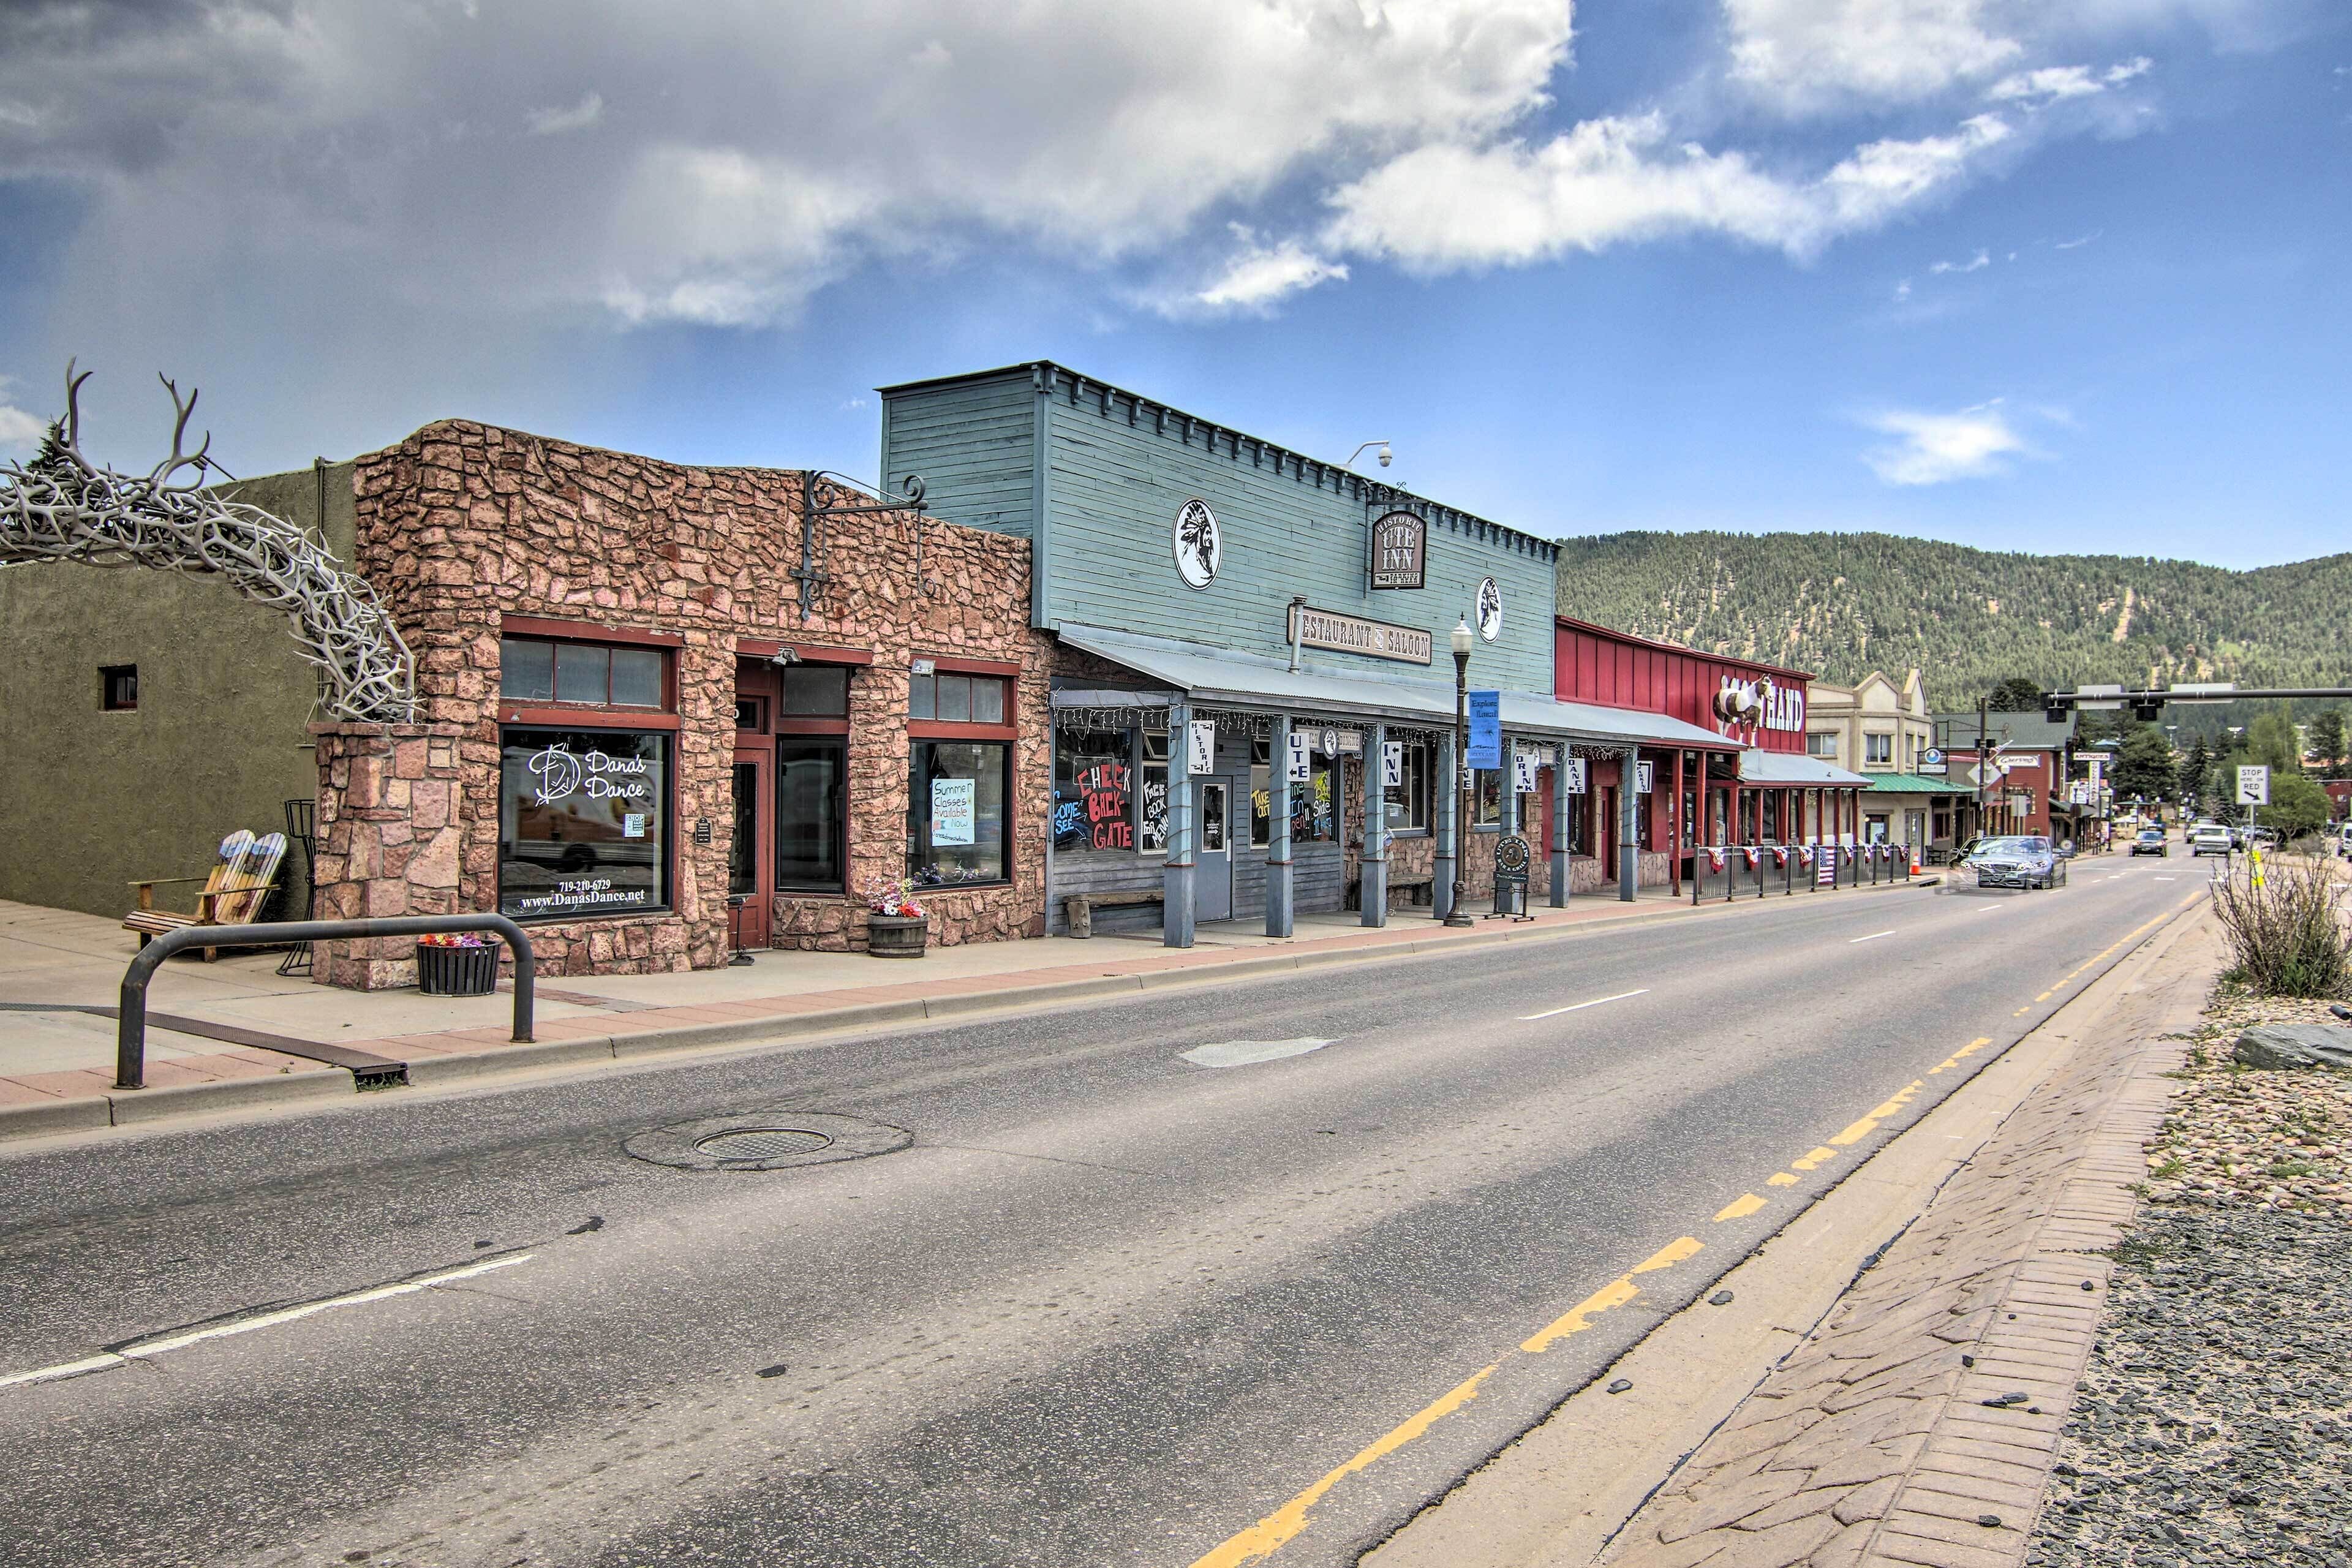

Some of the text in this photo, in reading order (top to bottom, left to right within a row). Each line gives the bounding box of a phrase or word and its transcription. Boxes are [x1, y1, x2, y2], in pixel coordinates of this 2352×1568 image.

[1376, 516, 1422, 534] HISTORIC
[1382, 526, 1415, 549] UTE
[1382, 548, 1414, 570] INN
[1293, 611, 1372, 649] ESTAURANT
[1388, 630, 1429, 659] SALOON
[1471, 699, 1498, 709] Explore
[1721, 674, 1803, 733] HAND
[1191, 723, 1211, 774] HISTORIC
[1290, 735, 1308, 778] UTE
[585, 749, 647, 774] Dana's
[1384, 744, 1398, 783] INN
[1077, 764, 1131, 798] CHECK
[1516, 756, 1533, 791] DRINK
[1568, 760, 1583, 793] DANCE
[1637, 766, 1647, 792] PARKING
[584, 775, 645, 799] Dance
[935, 782, 973, 796] Summer
[1291, 782, 1305, 797] ine
[934, 797, 967, 808] Classes
[1147, 797, 1167, 819] BOOK
[1251, 789, 1270, 809] TAKE
[1313, 800, 1332, 817] Side
[933, 807, 968, 818] Available
[951, 819, 968, 827] Now
[1055, 819, 1074, 834] SEE
[1093, 821, 1133, 850] GATE
[1143, 820, 1155, 835] FOR
[1496, 838, 1529, 858] UTE INN
[1498, 858, 1507, 869] BAR
[1512, 861, 1527, 872] GRILL
[559, 878, 611, 892] 719-210-6729
[522, 889, 646, 908] www.DanasDance.net
